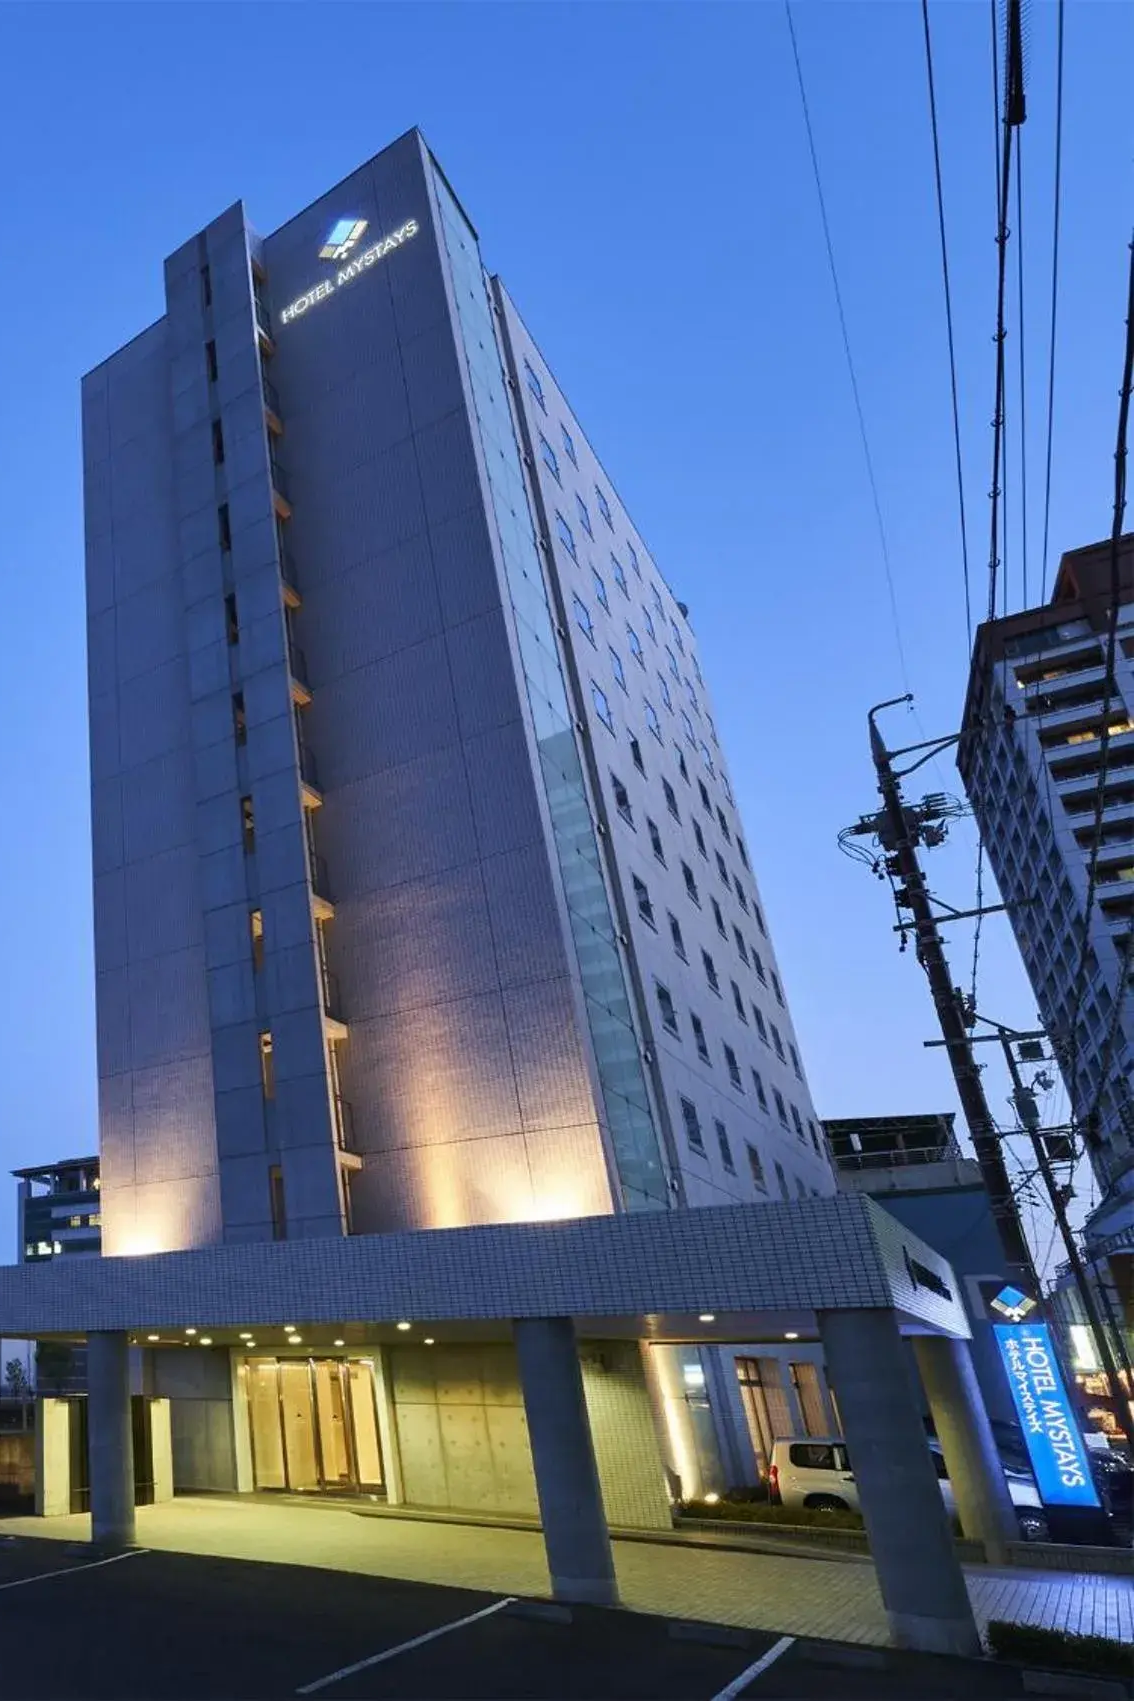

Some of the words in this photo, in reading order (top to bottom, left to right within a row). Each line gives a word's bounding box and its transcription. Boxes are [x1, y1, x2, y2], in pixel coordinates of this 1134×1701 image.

[281, 279, 335, 324] HOTEL
[337, 219, 419, 285] MYSTAYS
[1021, 1337, 1057, 1395] HOTEL
[1040, 1399, 1085, 1487] MYSTAYS
